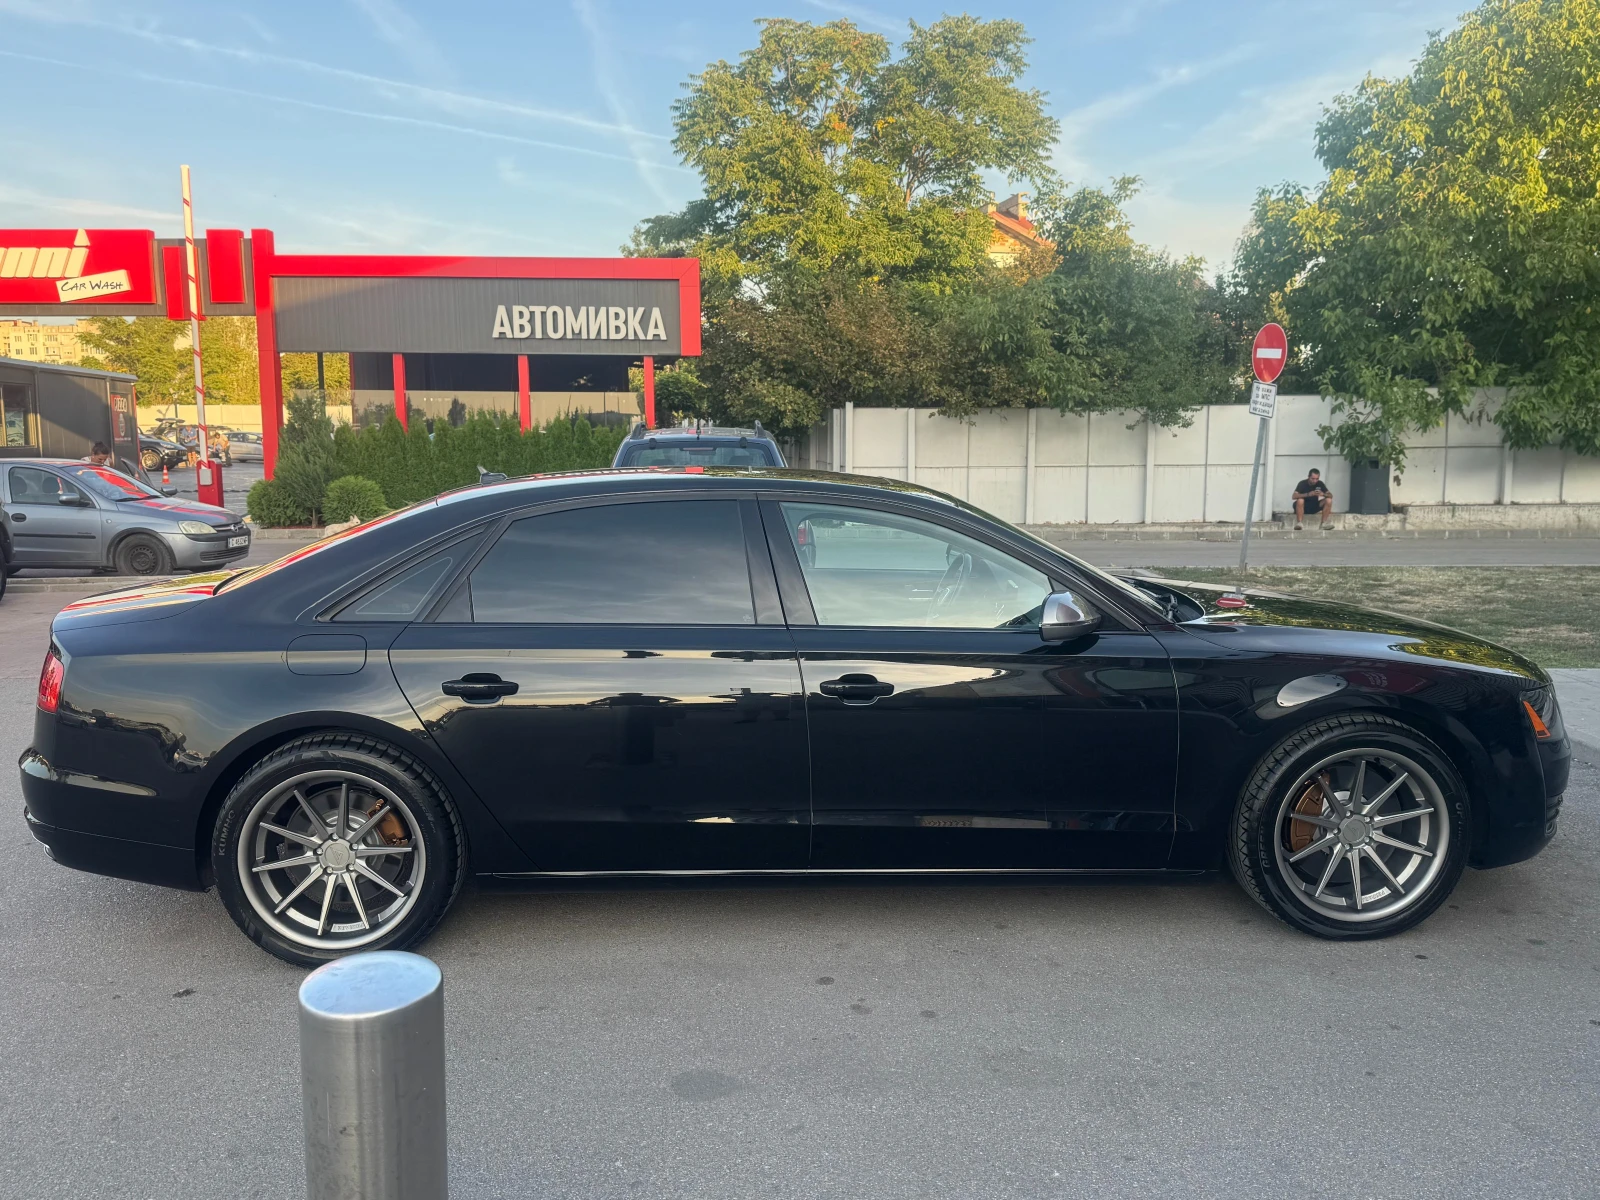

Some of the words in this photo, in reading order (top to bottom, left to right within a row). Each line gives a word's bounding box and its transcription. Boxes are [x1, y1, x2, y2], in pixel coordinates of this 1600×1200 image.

[60, 281, 87, 292] CAR
[89, 280, 124, 290] WASH
[492, 305, 668, 341] АВТОМИВКА
[218, 809, 236, 856] KUMHO
